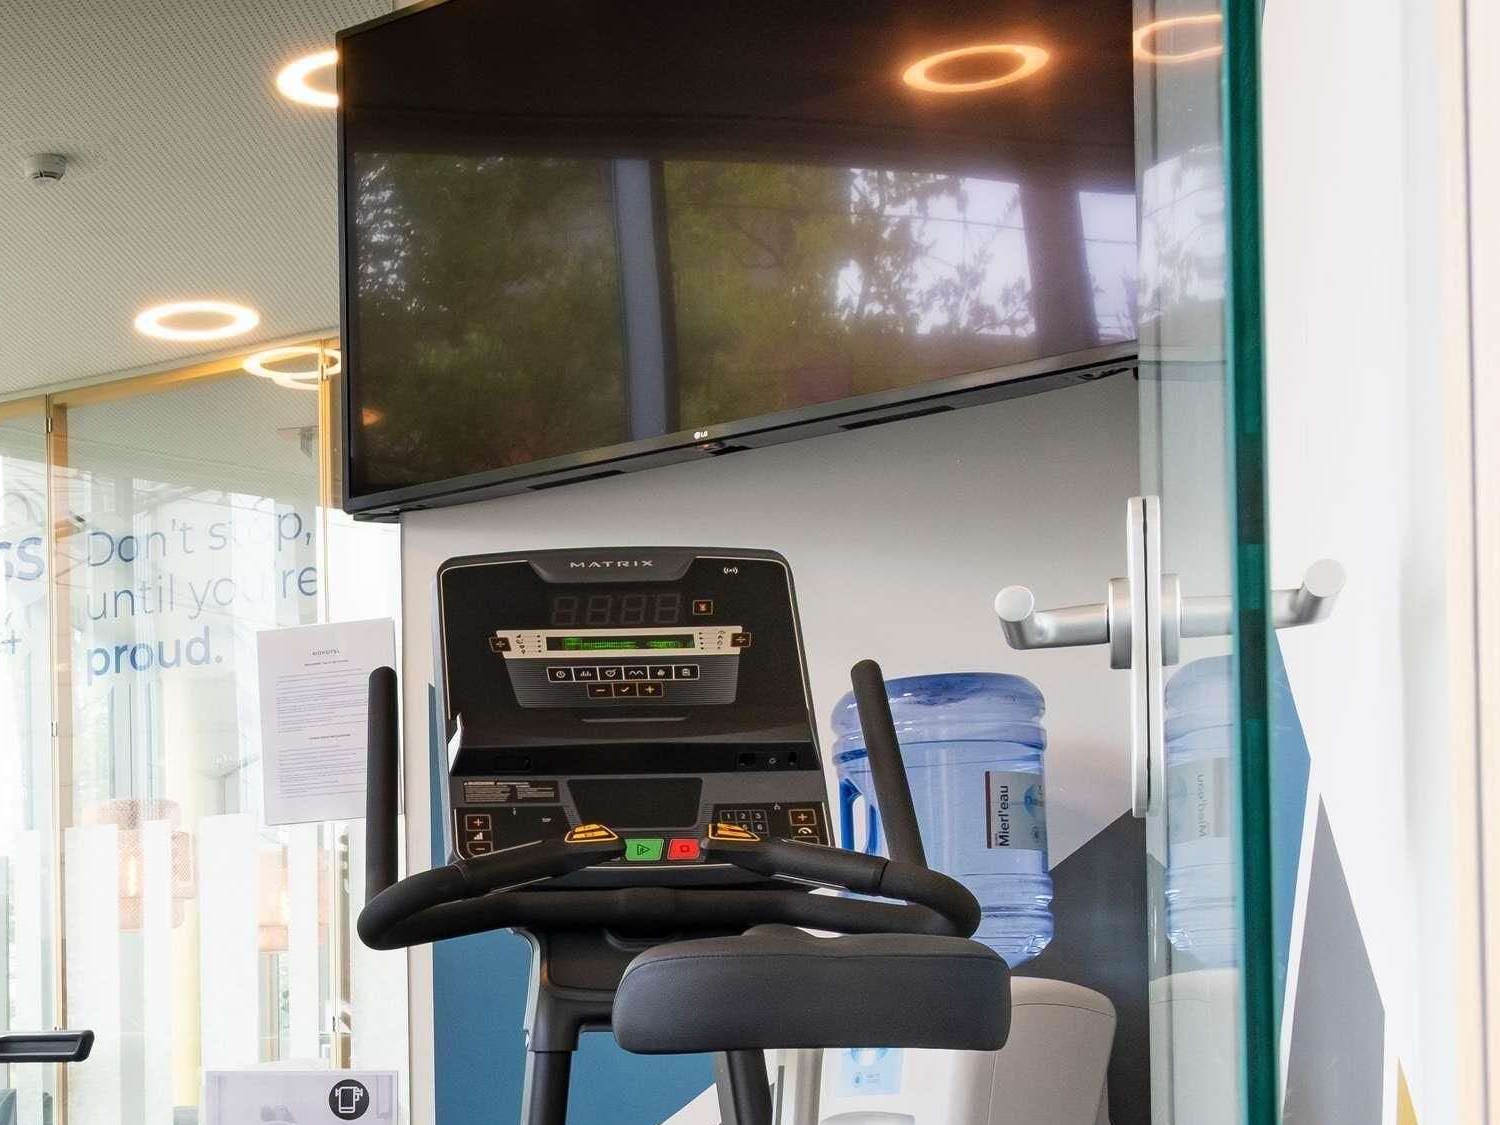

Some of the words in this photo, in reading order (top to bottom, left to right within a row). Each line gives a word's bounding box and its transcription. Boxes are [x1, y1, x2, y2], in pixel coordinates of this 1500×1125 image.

[86, 518, 195, 567] Don't
[570, 560, 653, 569] MATRIX
[86, 574, 174, 621] until
[86, 625, 223, 686] proud.
[998, 785, 1010, 847] Mierl'eau
